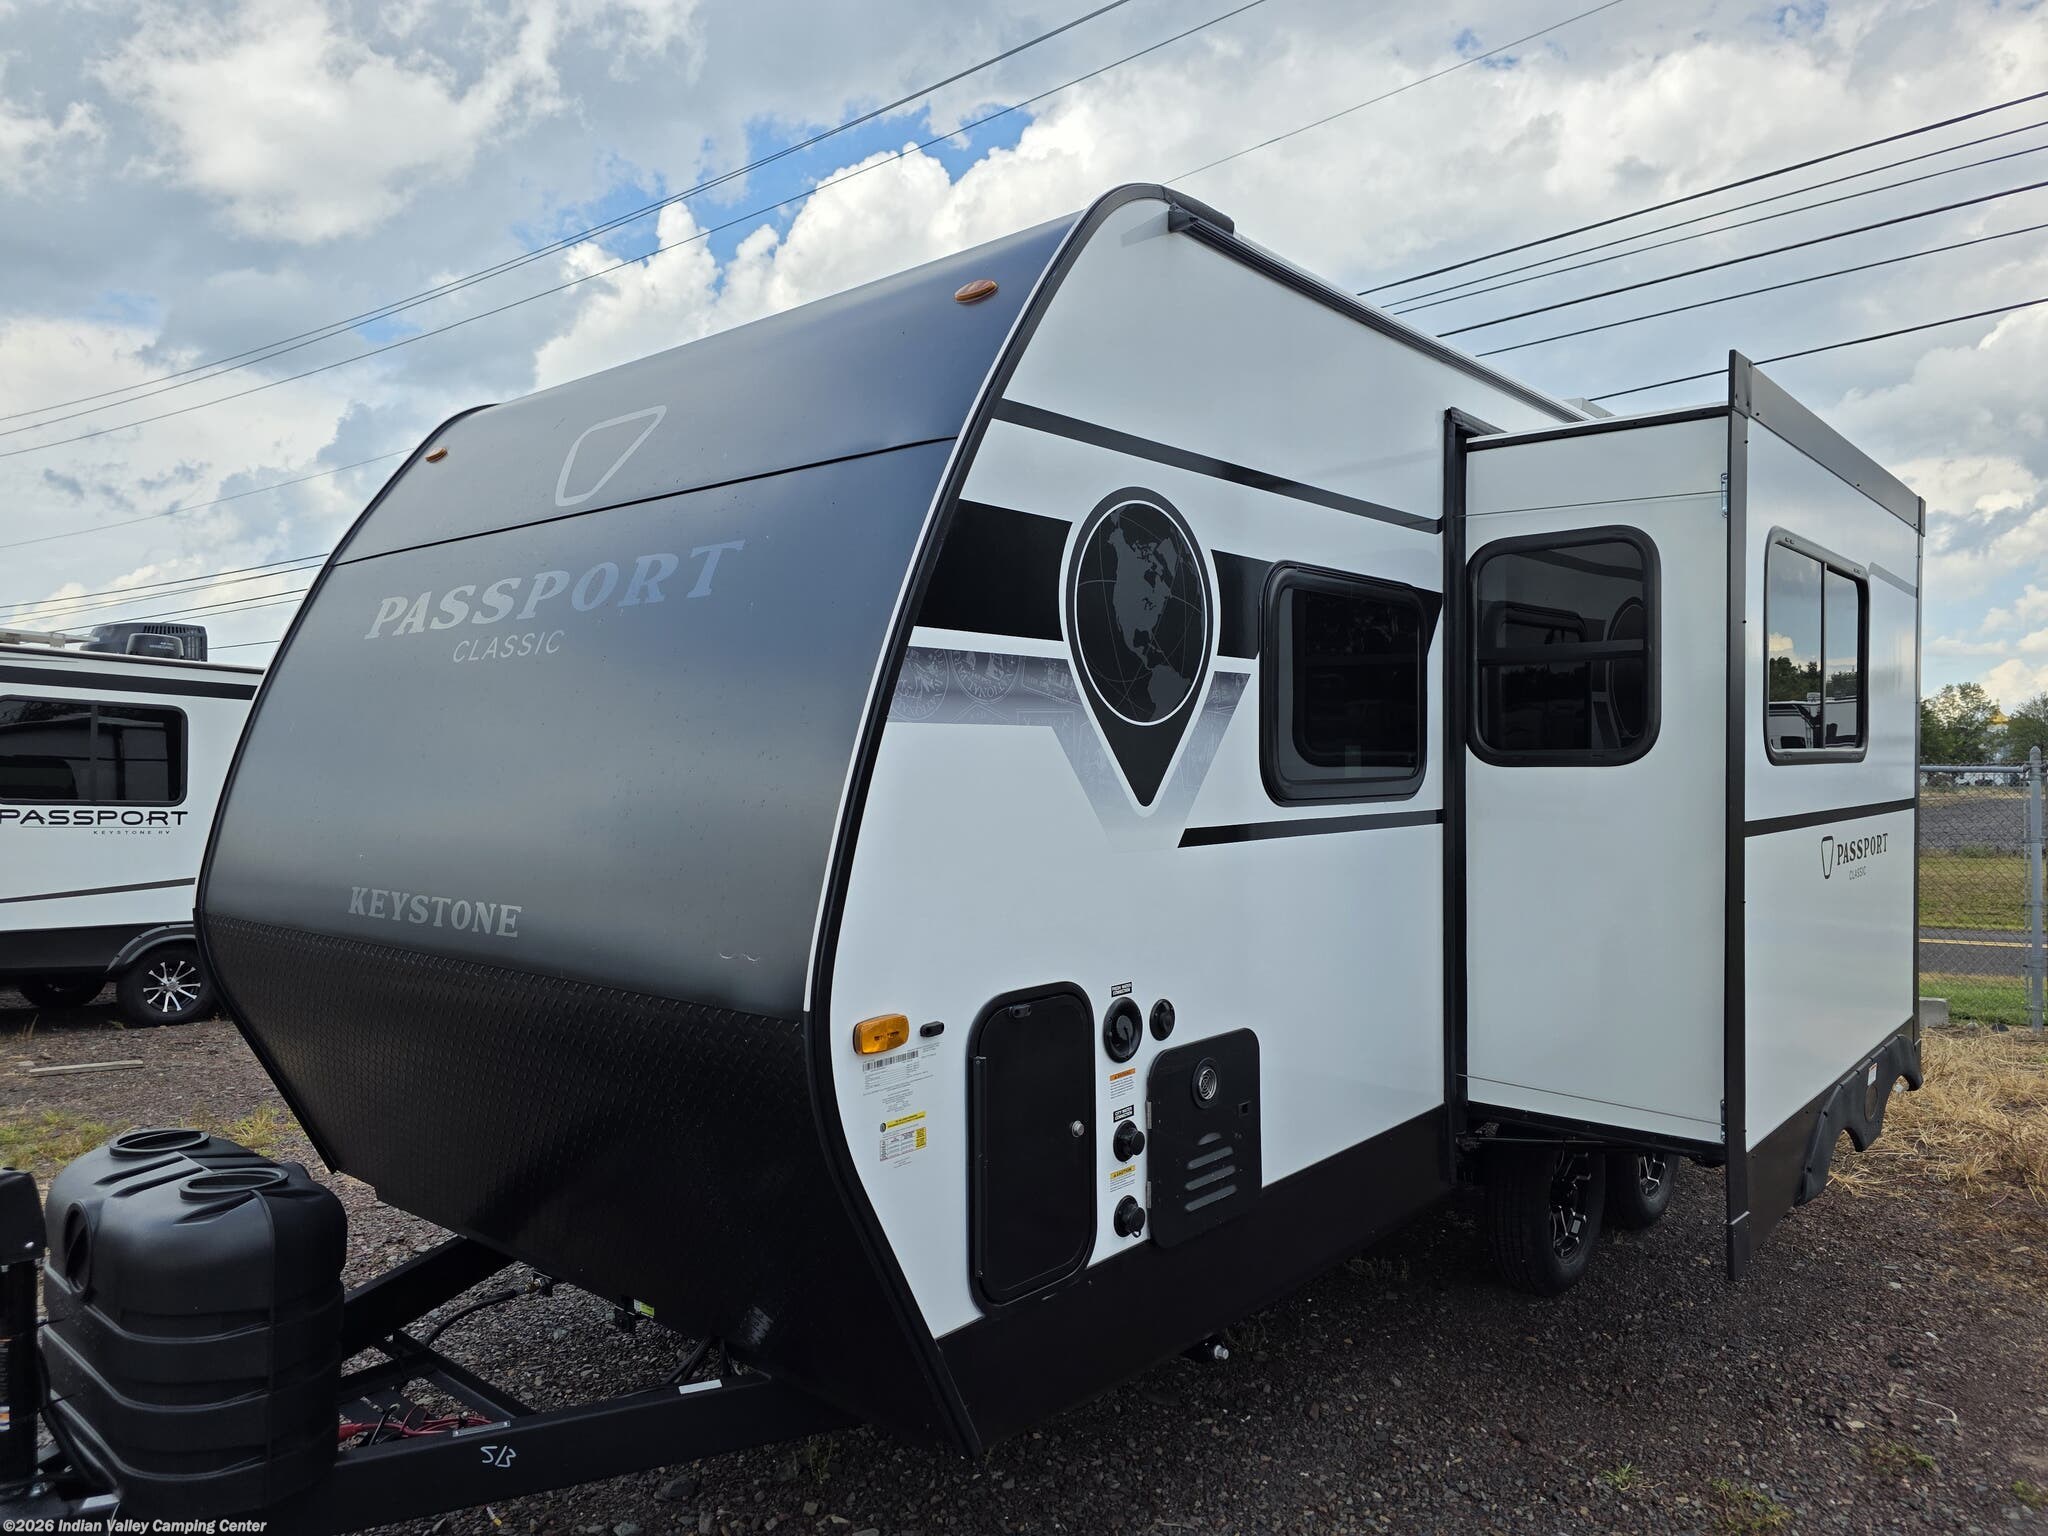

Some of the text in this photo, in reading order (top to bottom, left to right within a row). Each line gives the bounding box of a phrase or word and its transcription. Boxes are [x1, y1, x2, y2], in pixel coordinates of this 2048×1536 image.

[364, 539, 745, 640] PASSPORT
[452, 629, 566, 663] CLASSIC
[0, 809, 189, 825] PASSPORT
[1837, 833, 1888, 865] PASSPORT
[348, 886, 523, 939] KEYSTONE
